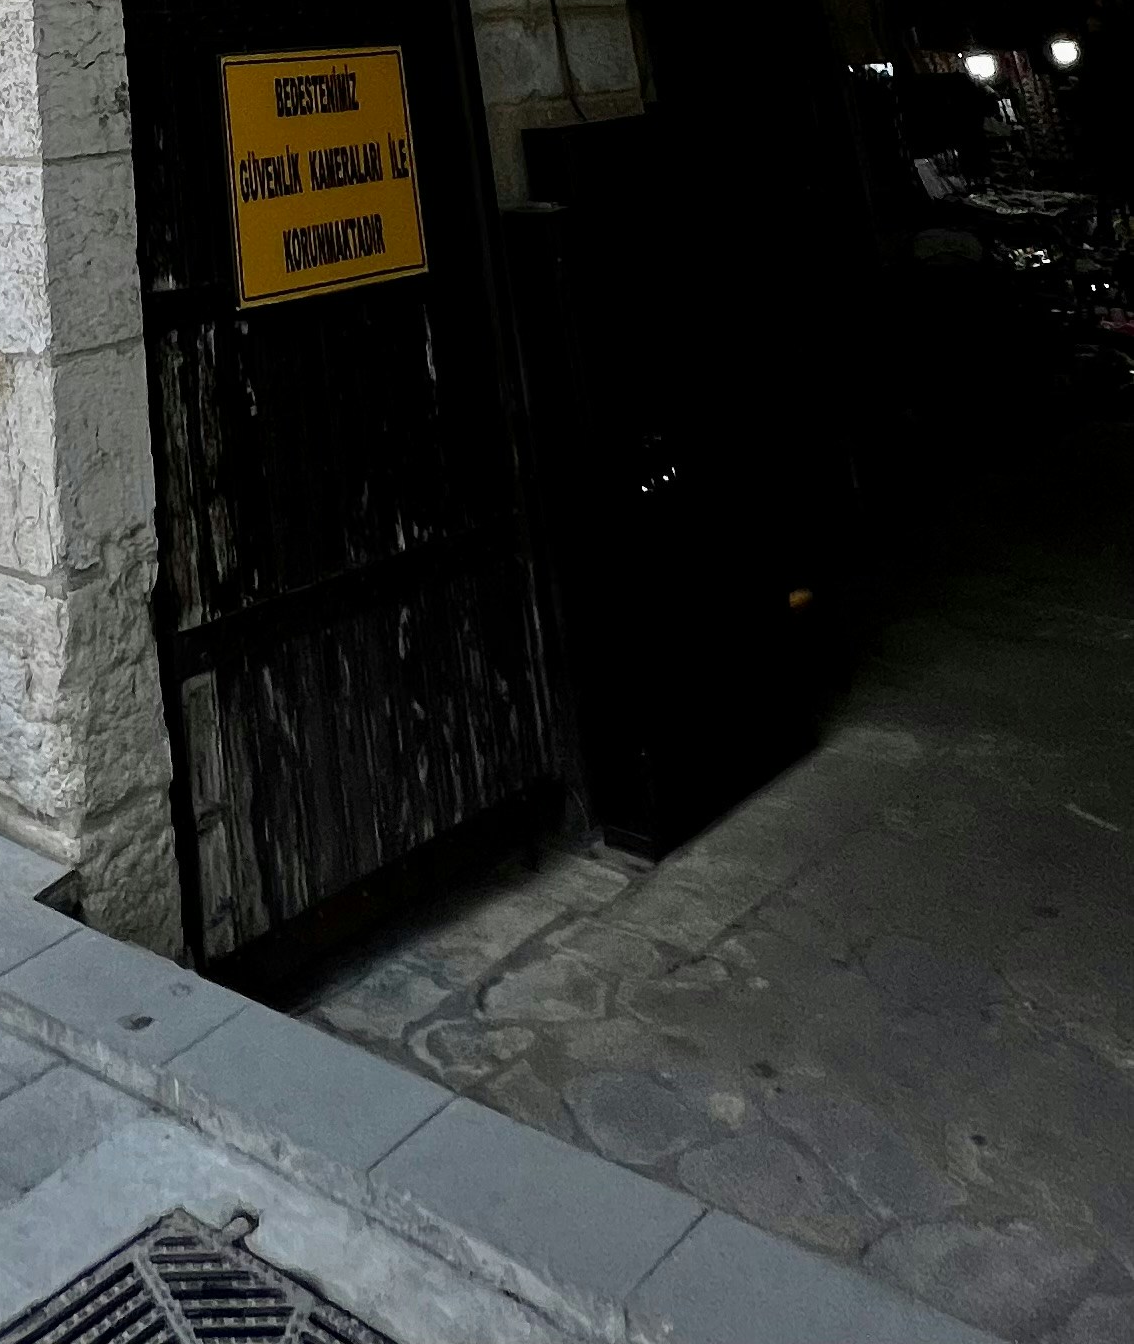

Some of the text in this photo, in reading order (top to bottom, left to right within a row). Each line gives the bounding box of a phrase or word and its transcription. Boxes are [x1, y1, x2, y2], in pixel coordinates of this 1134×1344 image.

[274, 64, 359, 117] BEDESTENİMİZ
[239, 132, 409, 203] GÜVENLİK KAMERALARI İLE
[283, 214, 385, 273] KORUNMAKTADIR
